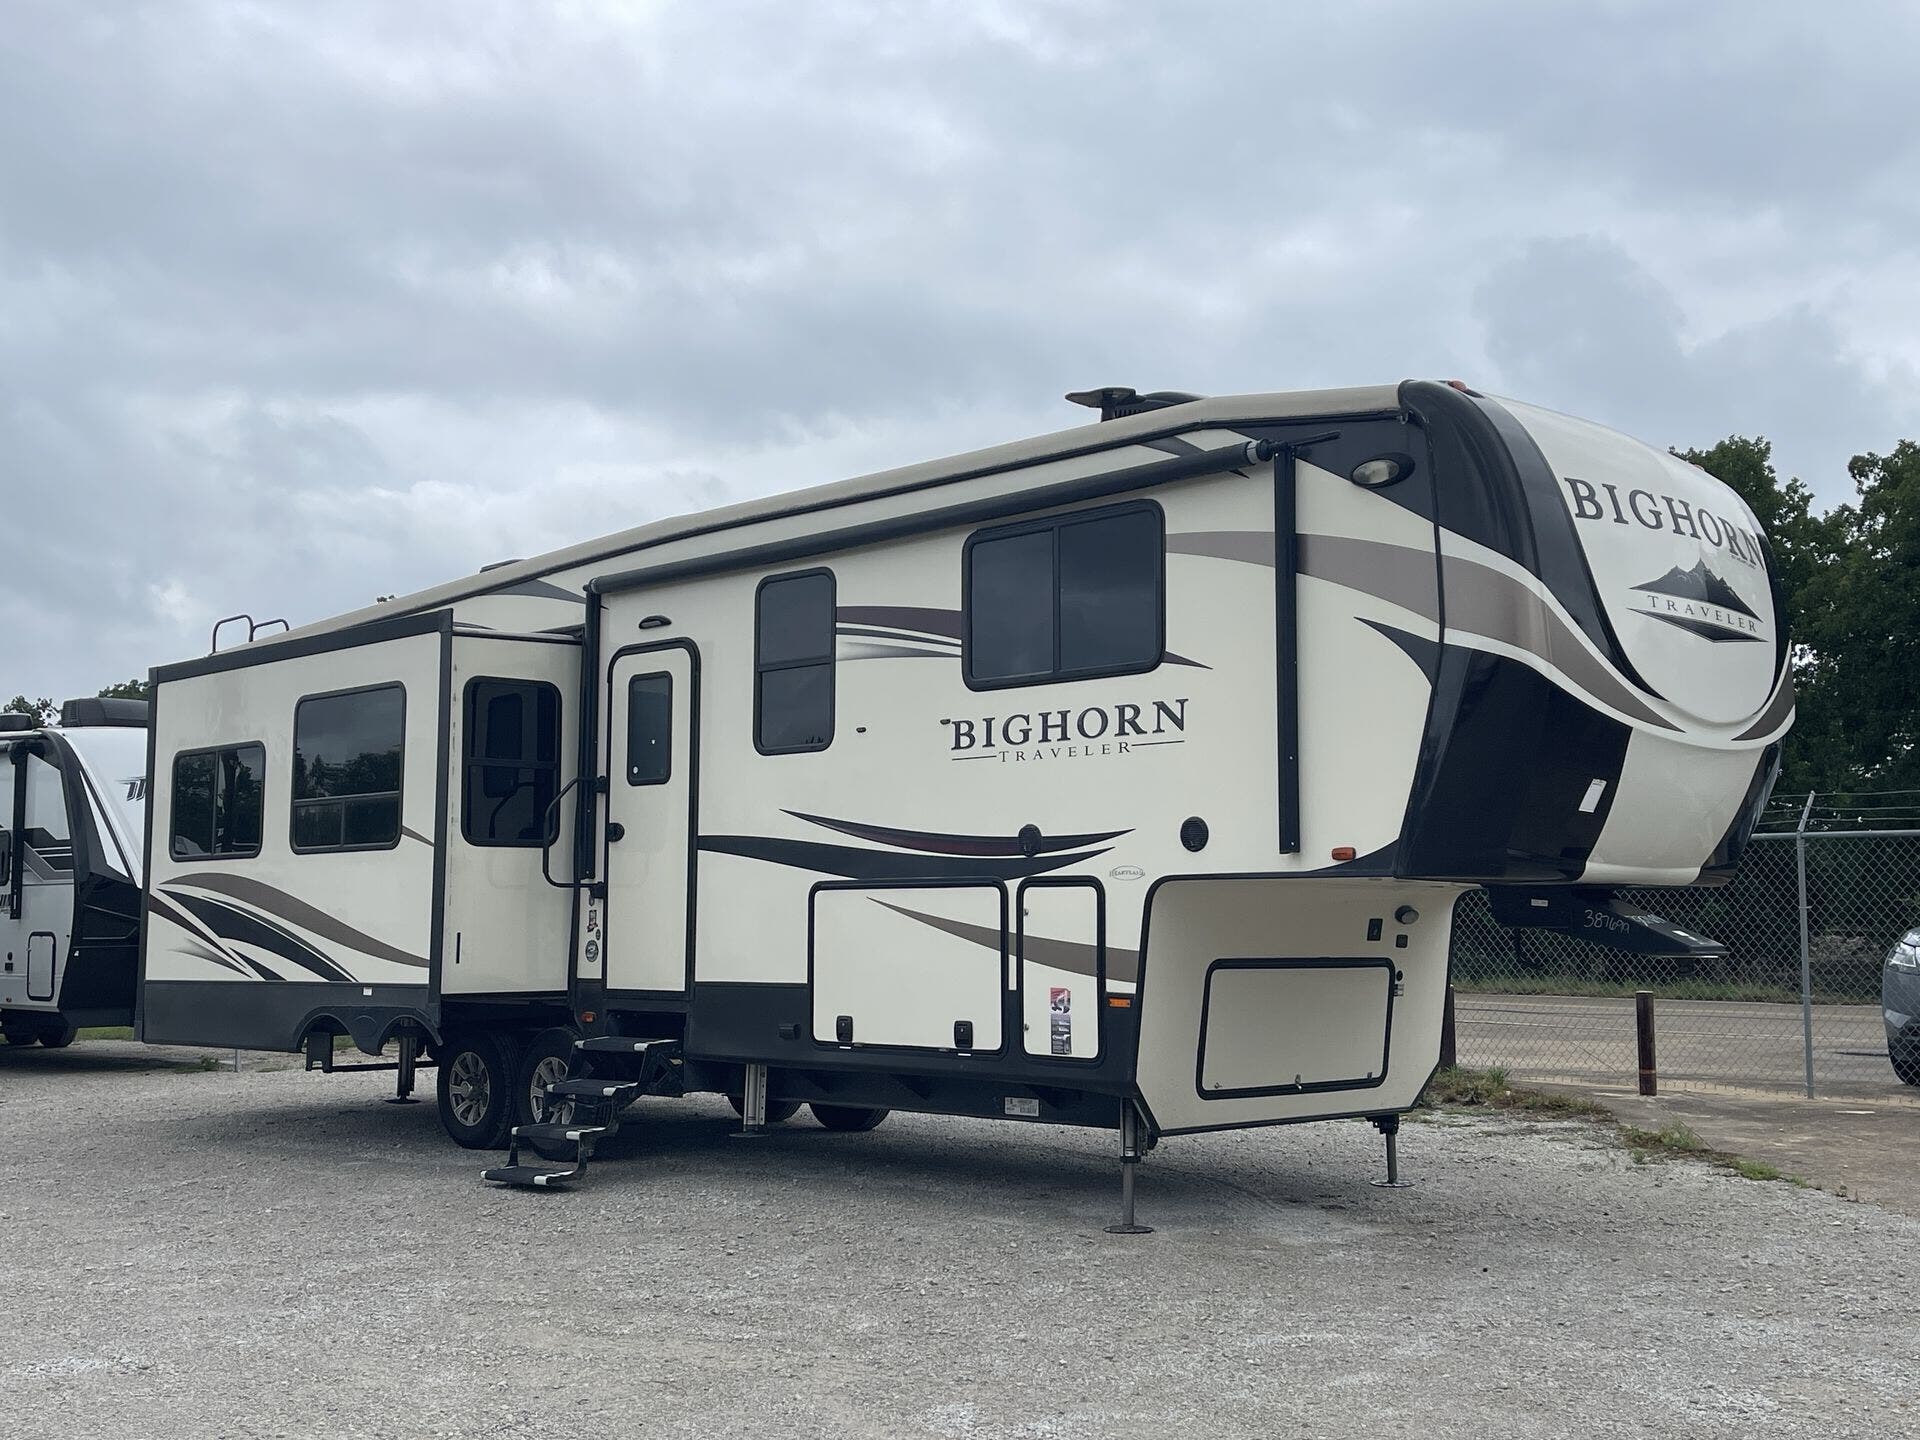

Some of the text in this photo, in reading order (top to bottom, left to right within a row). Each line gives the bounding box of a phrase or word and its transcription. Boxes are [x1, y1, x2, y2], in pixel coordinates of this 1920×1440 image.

[1564, 477, 1765, 571] BIGHORN
[1648, 595, 1758, 633] TRAVELER
[951, 698, 1189, 750] BIGHORN
[999, 741, 1131, 763] TRAVELER
